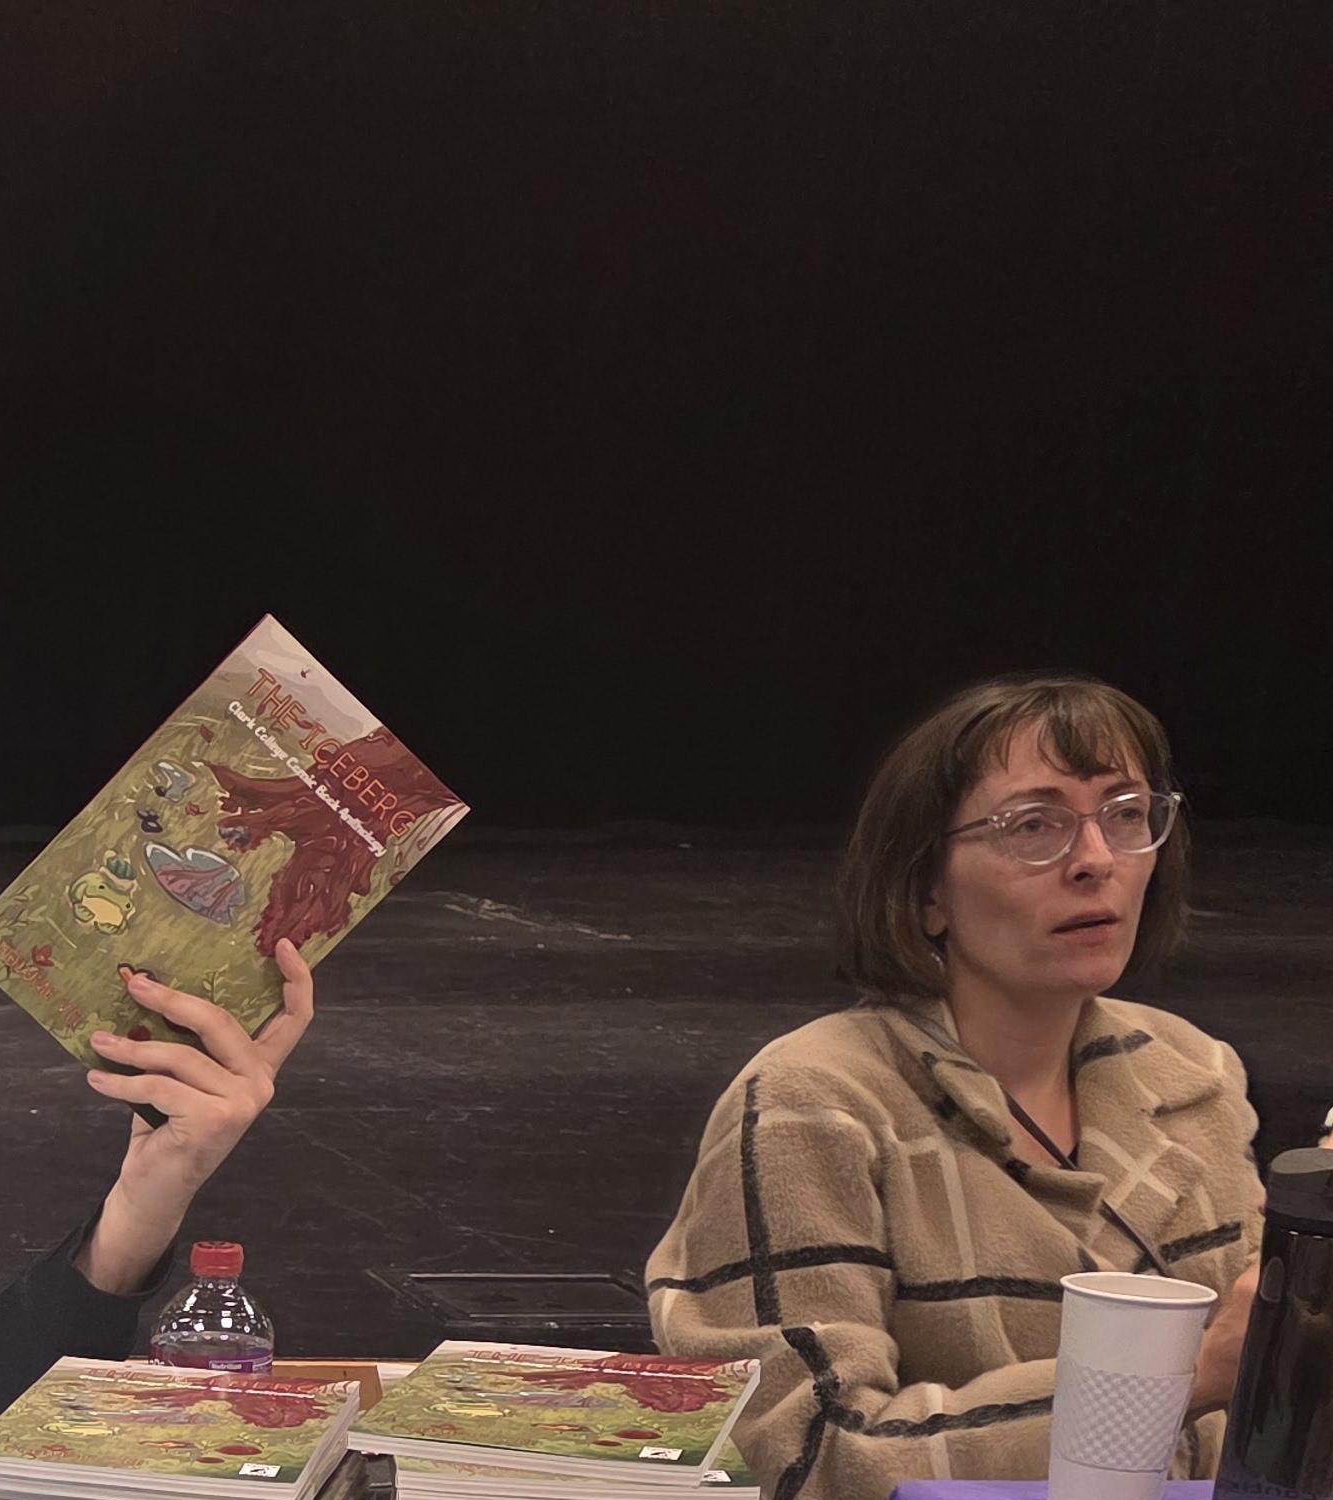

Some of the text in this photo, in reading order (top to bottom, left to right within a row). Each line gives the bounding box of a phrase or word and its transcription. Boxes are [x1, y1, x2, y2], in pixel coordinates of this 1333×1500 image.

[229, 700, 257, 730] Clark
[254, 726, 289, 761] College
[286, 756, 317, 789] Comic
[315, 784, 340, 812] Book
[247, 668, 416, 838] THE ICEBERG
